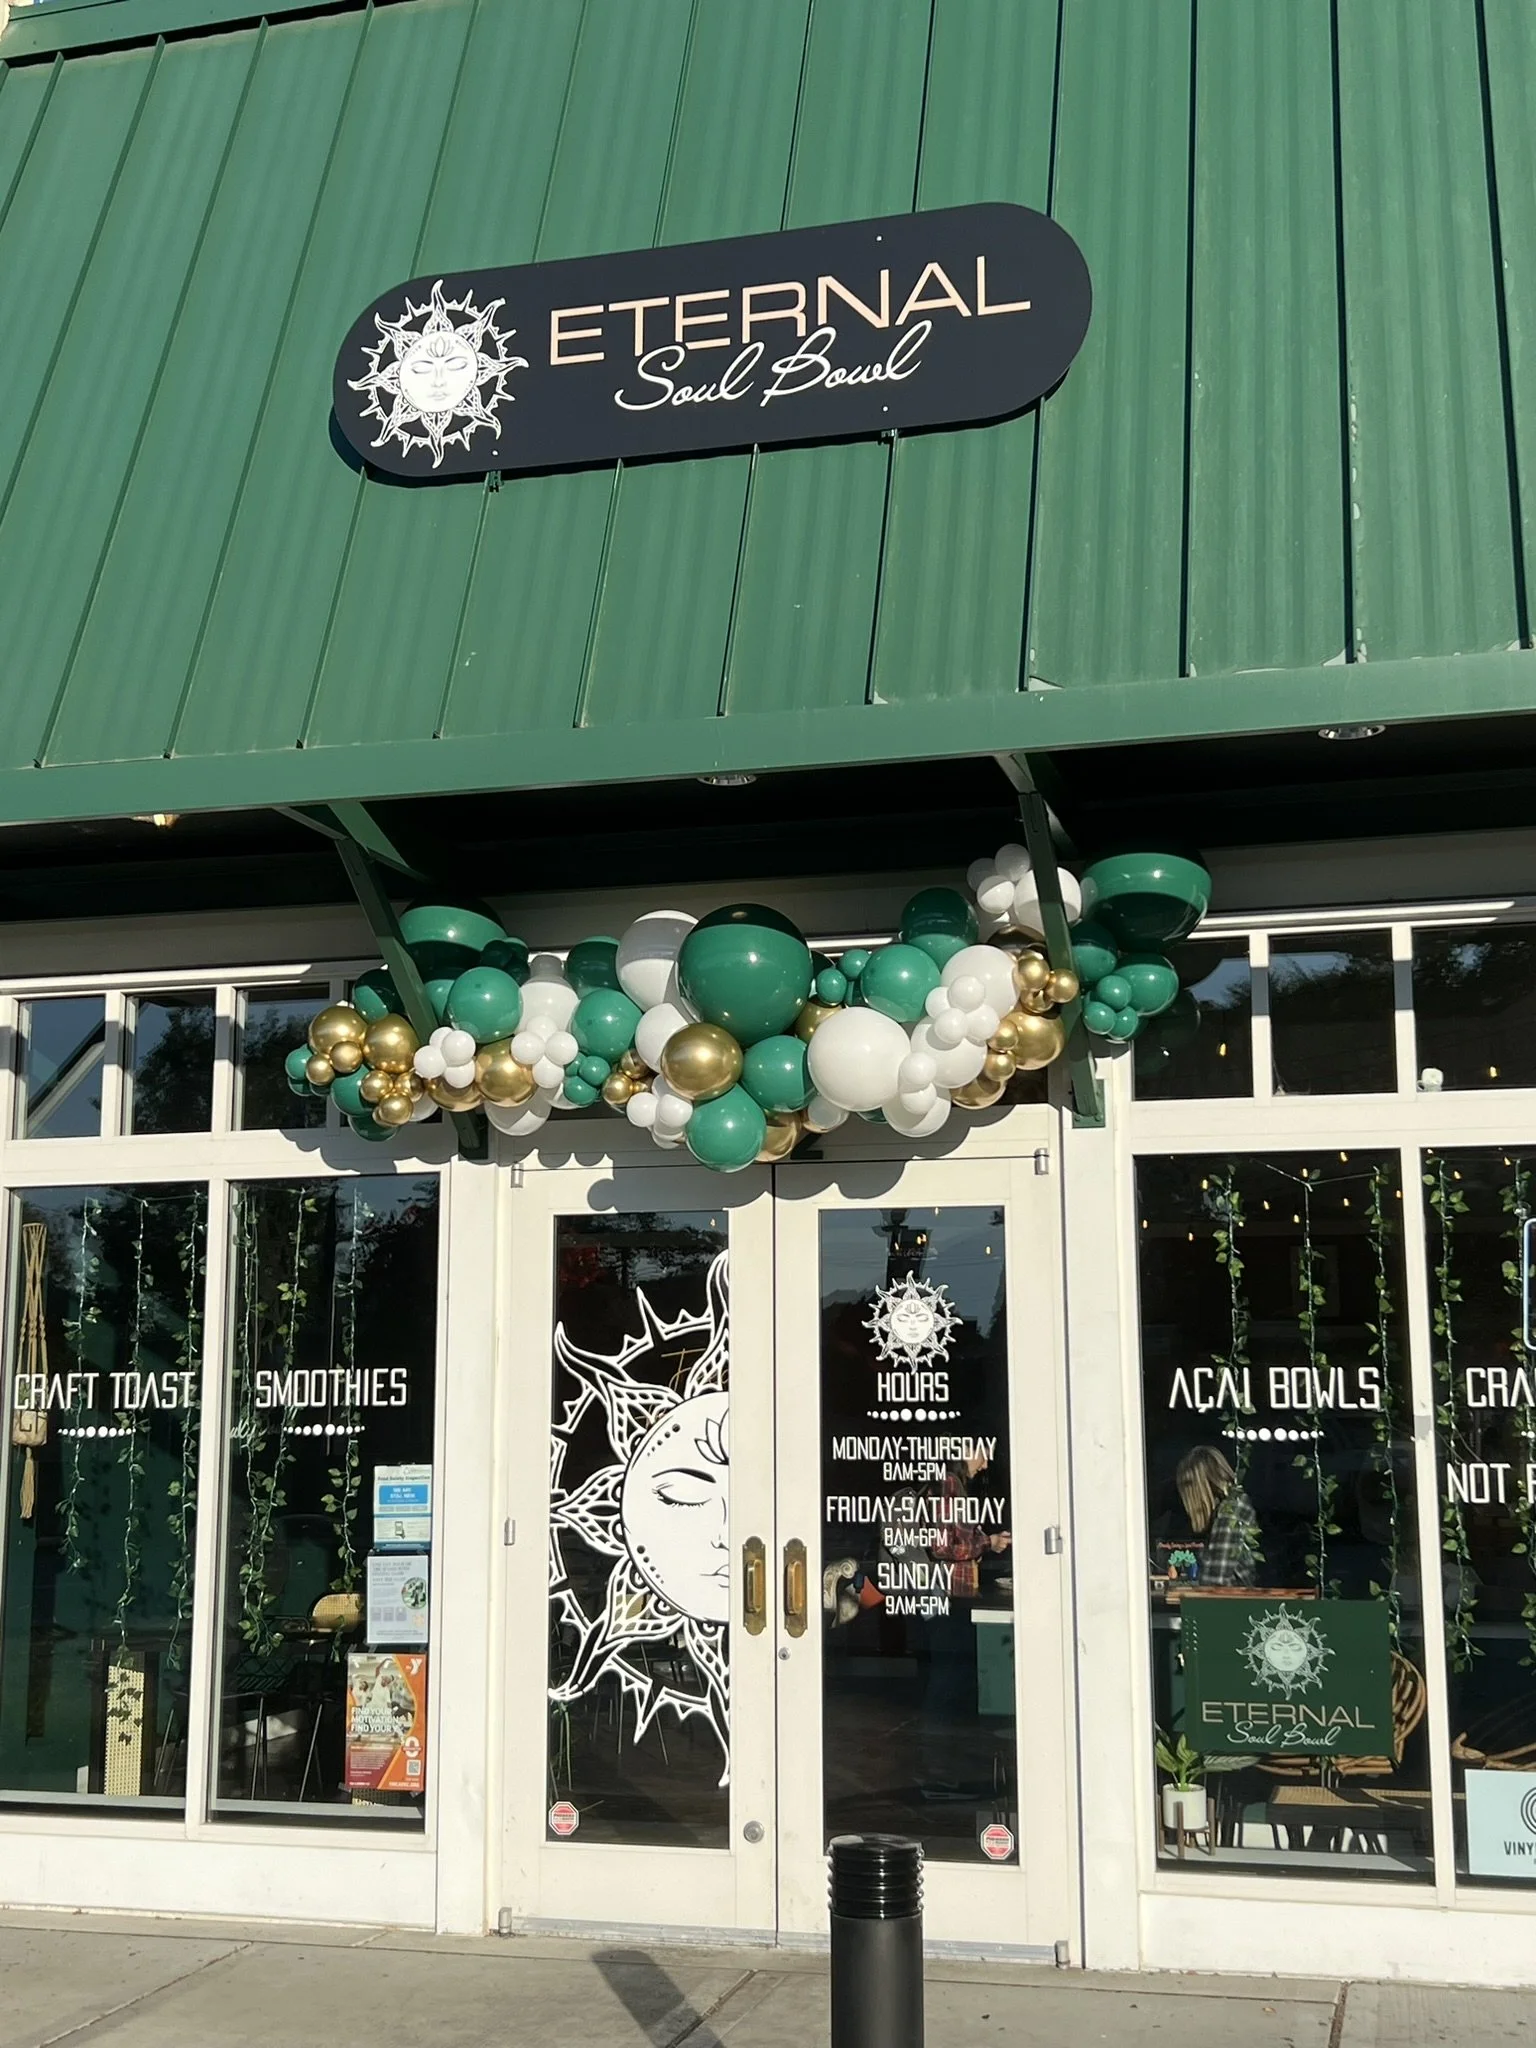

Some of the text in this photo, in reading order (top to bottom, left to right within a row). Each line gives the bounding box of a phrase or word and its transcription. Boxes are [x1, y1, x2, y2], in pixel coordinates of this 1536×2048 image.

[550, 255, 1031, 367] ETERNAL
[614, 319, 933, 411] Soul Bowl
[13, 1371, 196, 1410] CRAFT TOAST
[255, 1368, 408, 1409] SMOOTHIES
[877, 1372, 949, 1402] HOURS
[1168, 1366, 1381, 1413] AÇAI BOWLS
[1466, 1367, 1536, 1408] CRA
[832, 1436, 997, 1461] MONDAY-THURSDAY
[883, 1462, 947, 1481] 8AM-5PM
[1446, 1462, 1511, 1503] NOT
[826, 1495, 1005, 1524] FRIDAY-SATURDAY
[884, 1527, 948, 1547] 8AM-6PM
[877, 1562, 955, 1591] SUNDAY
[885, 1595, 949, 1616] 9AM-5PM
[351, 1706, 392, 1715] FIND YOUR
[351, 1715, 399, 1723] MOTIVATION
[1202, 1701, 1375, 1728] ETERNAL
[351, 1723, 370, 1732] FIND
[370, 1724, 392, 1732] YOUR
[1227, 1720, 1342, 1748] Soul Bowl
[1503, 1841, 1536, 1855] VINY
